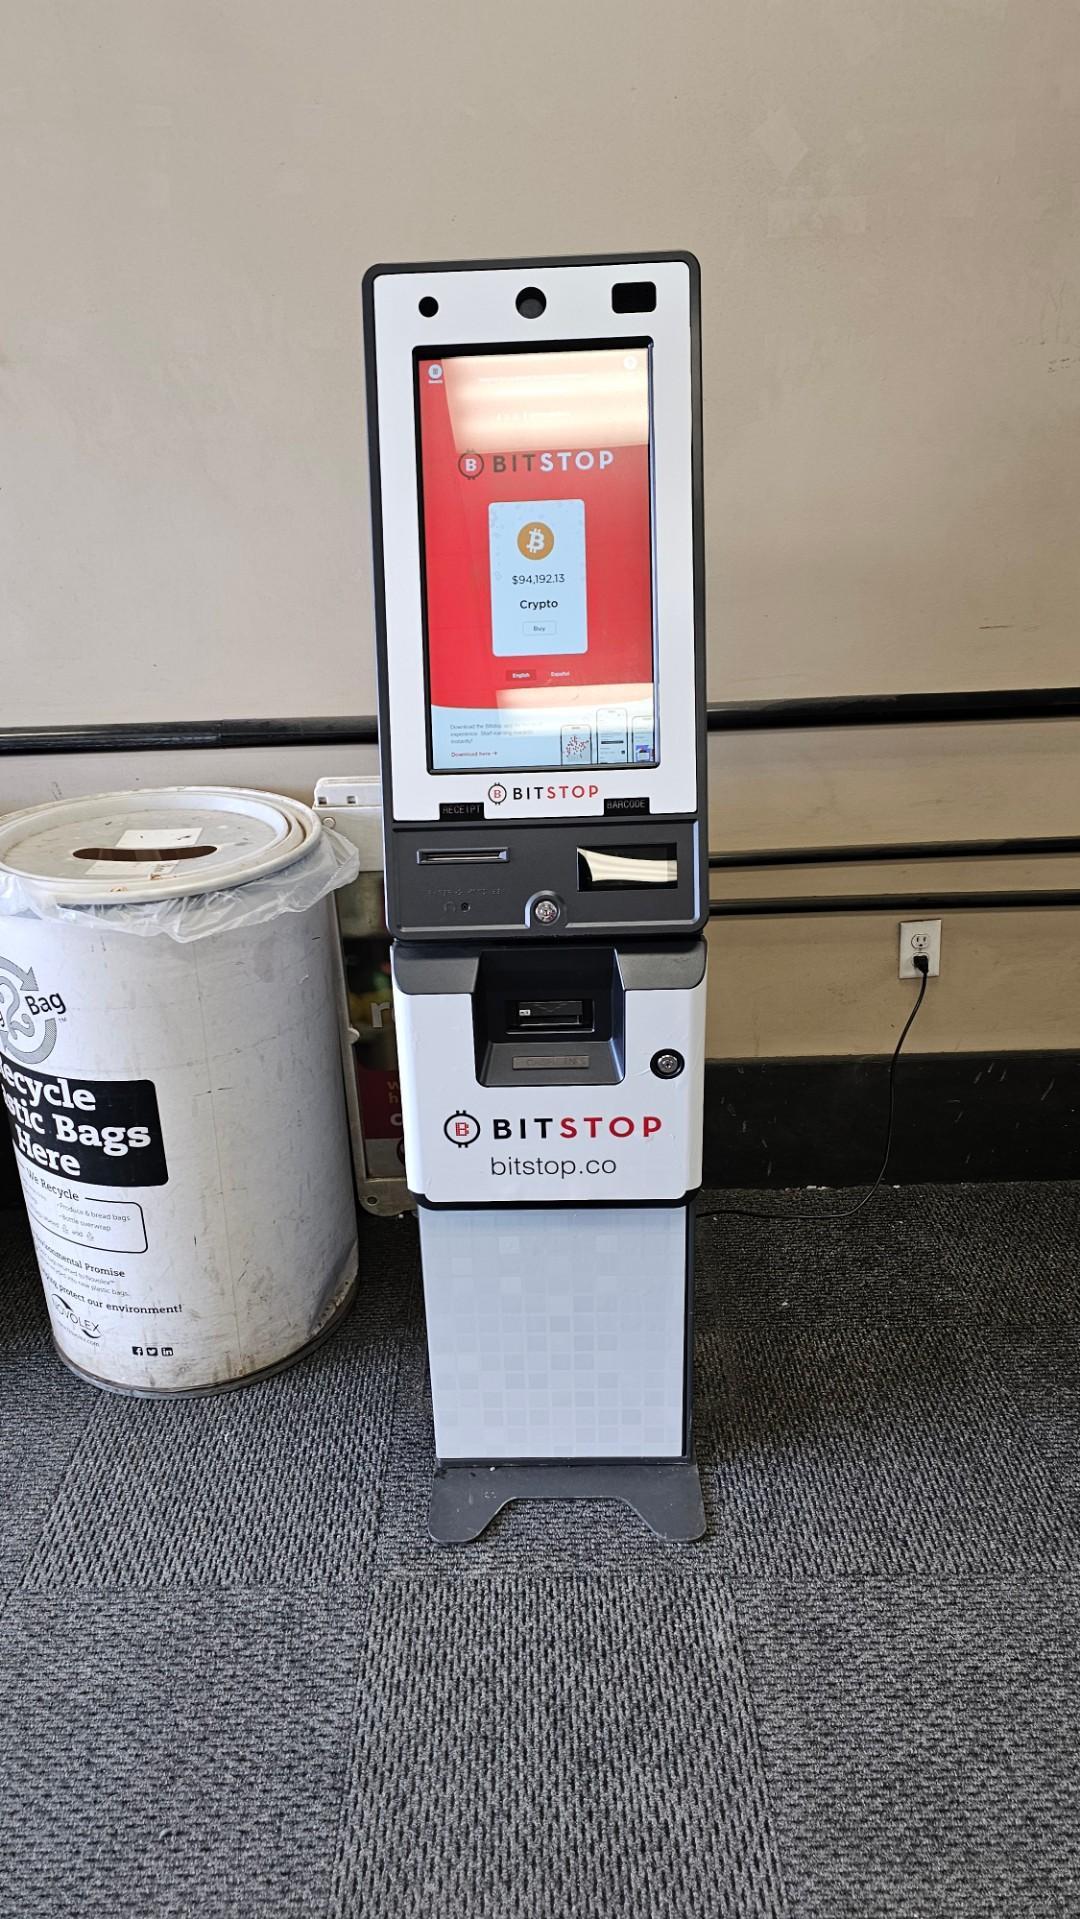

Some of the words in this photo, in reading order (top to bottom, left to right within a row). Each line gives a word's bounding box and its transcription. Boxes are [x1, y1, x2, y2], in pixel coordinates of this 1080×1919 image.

[492, 450, 614, 473] BITSTOP
[519, 599, 559, 611] Crypto
[512, 785, 599, 801] BITSTOP
[442, 804, 482, 815] RECEIPT
[606, 799, 646, 810] BARCODE
[25, 992, 67, 1015] Bag
[52, 1113, 151, 1157] Bags
[492, 1115, 663, 1140] BITSTOP
[14, 1123, 81, 1176] Here
[490, 1156, 617, 1179] bitstop.co
[40, 1178, 80, 1202] Recycle
[91, 1211, 111, 1221] bread
[112, 1213, 131, 1223] bags
[84, 1262, 126, 1277] Promise
[87, 1298, 103, 1309] our
[106, 1304, 183, 1315] environment!
